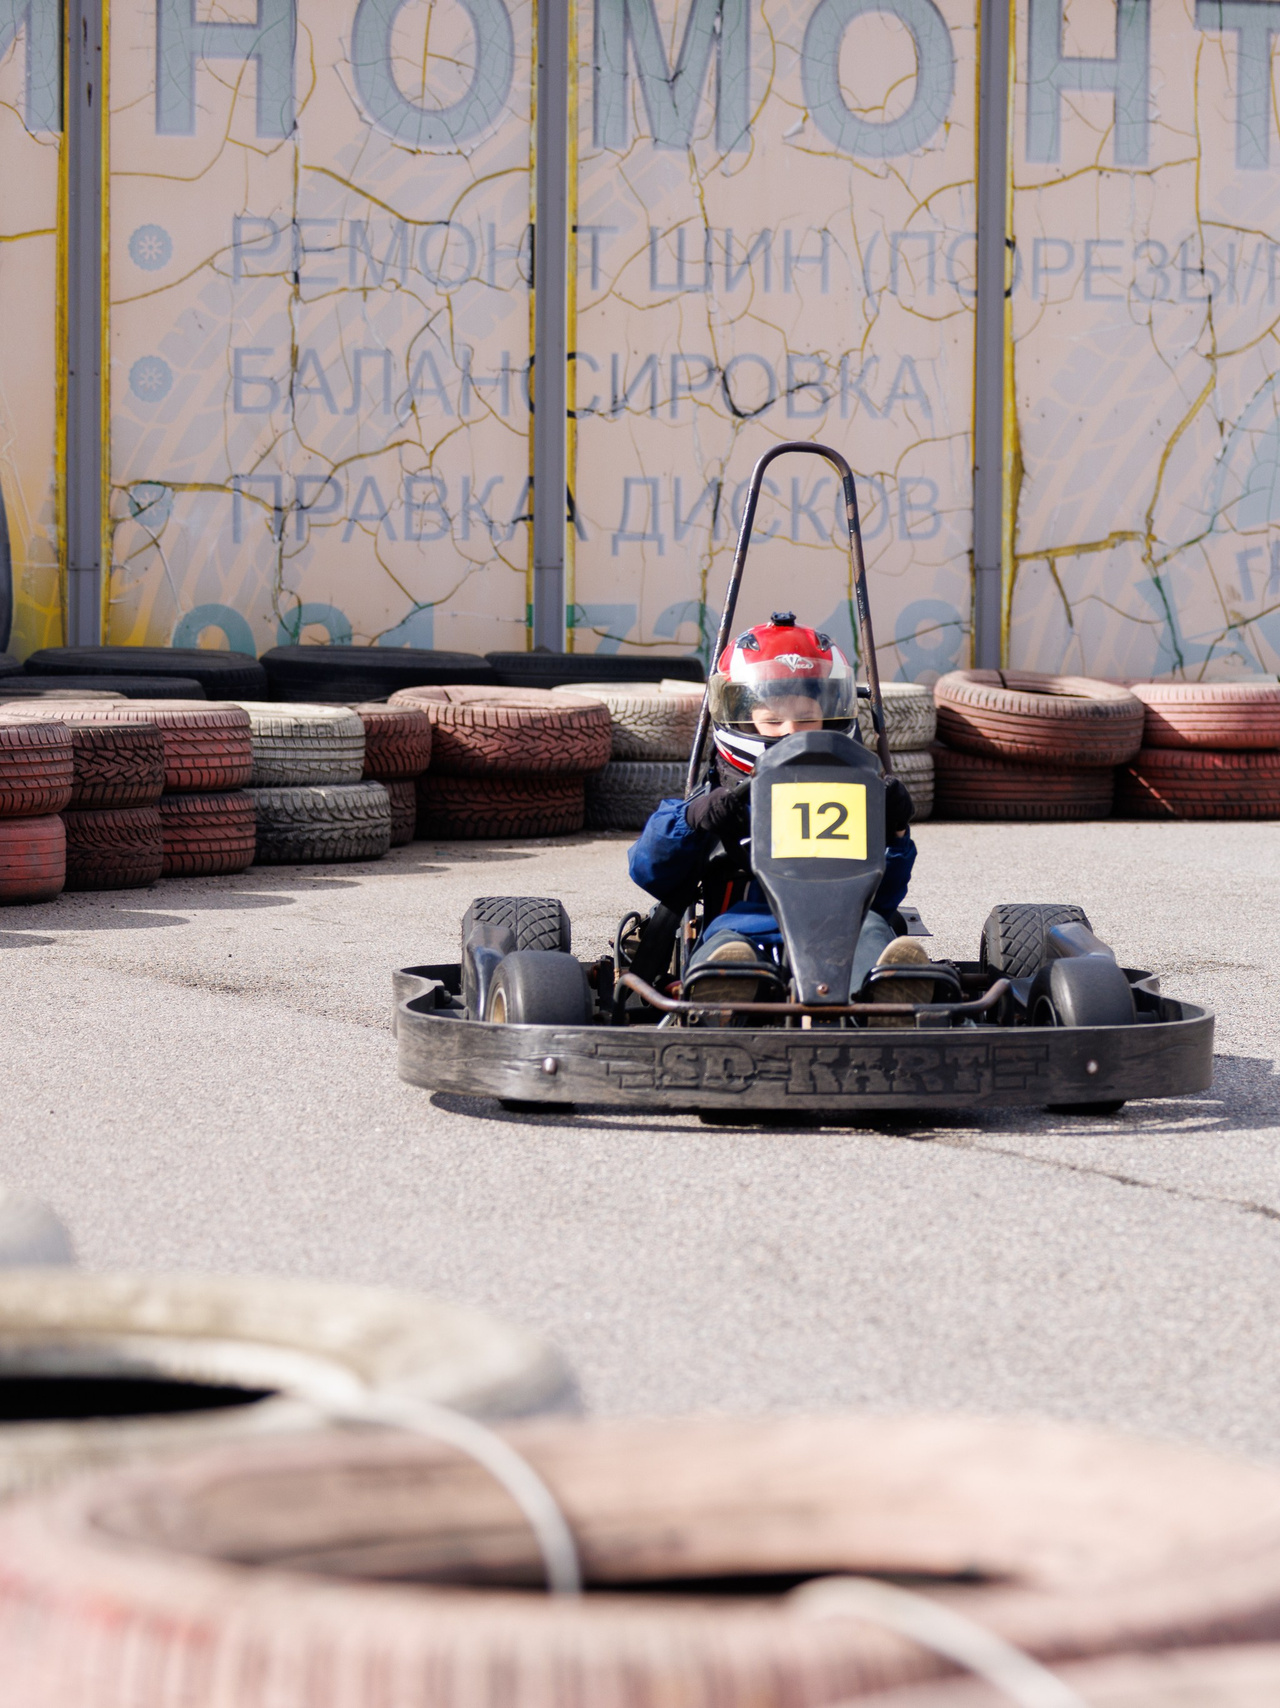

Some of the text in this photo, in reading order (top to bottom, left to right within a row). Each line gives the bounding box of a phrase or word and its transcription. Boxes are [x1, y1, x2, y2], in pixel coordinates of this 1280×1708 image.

[232, 215, 618, 291] РЕМОНТ
[649, 227, 831, 294] ШИН
[231, 347, 933, 420] БАЛАНСИРОВКА
[231, 474, 944, 556] ПРАВКА ДИСКОВ
[792, 801, 849, 840] 12
